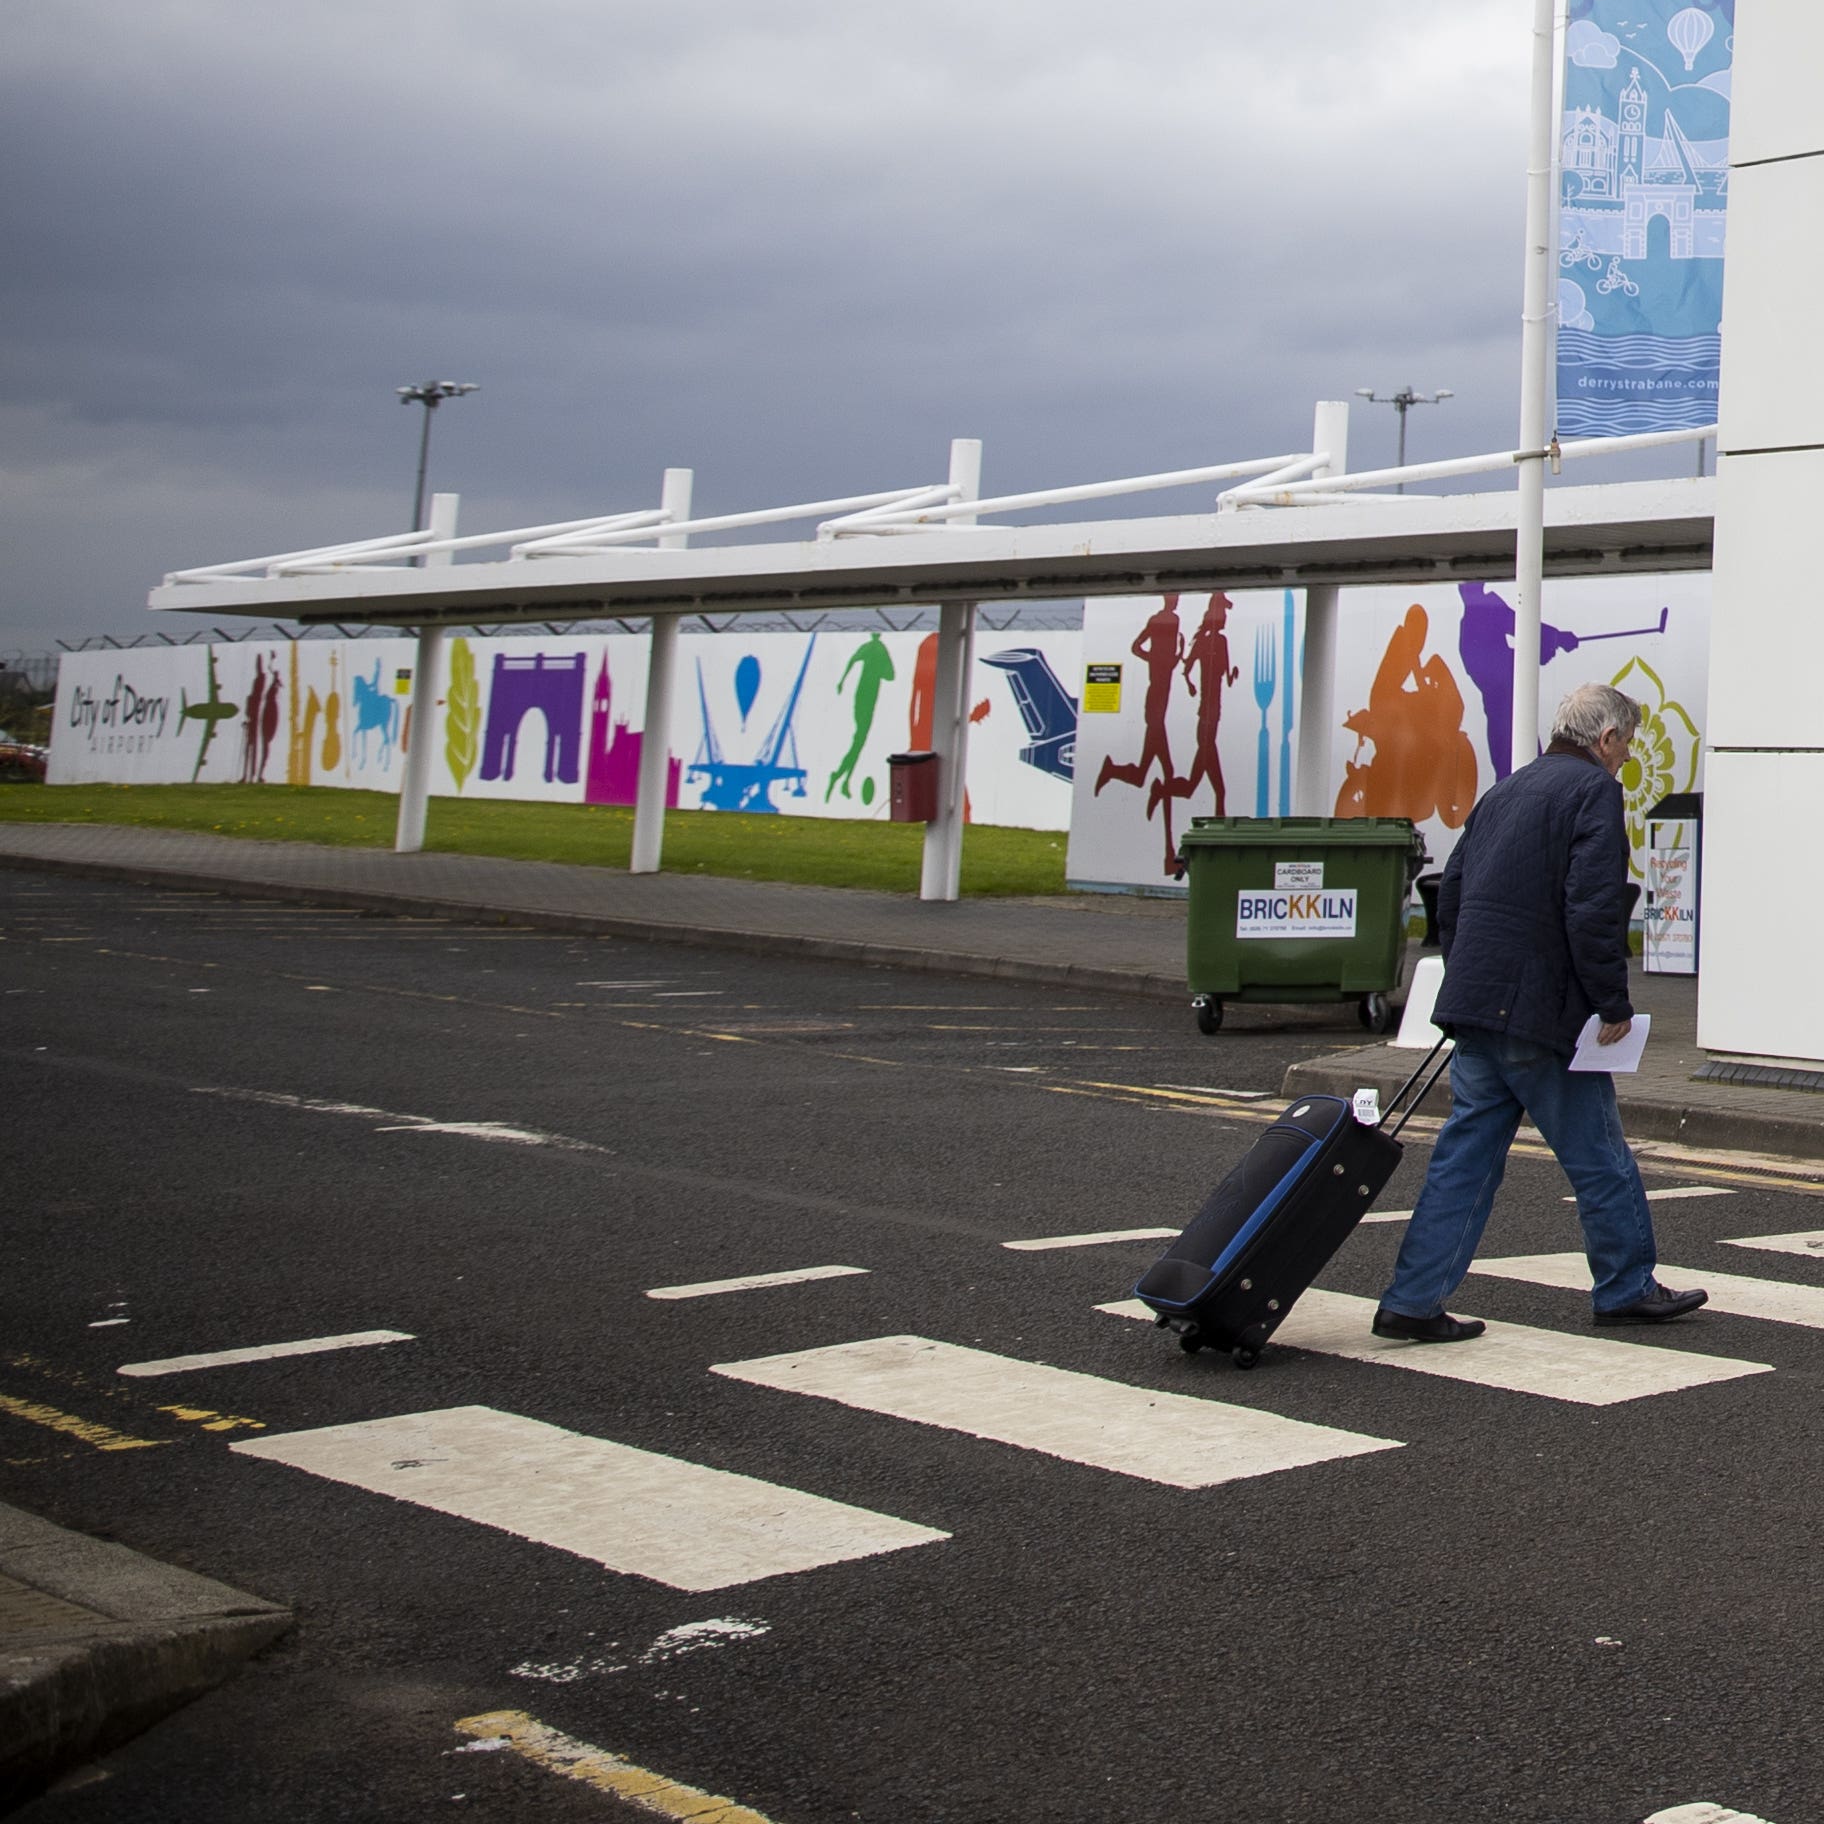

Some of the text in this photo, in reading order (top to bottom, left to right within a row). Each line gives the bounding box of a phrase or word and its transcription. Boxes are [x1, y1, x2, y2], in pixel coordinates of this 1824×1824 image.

[1577, 376, 1719, 391] derrystrabane.com
[70, 673, 171, 740] City of Derry
[90, 735, 155, 754] AIRPORT
[1650, 856, 1688, 871] Recycling
[1276, 868, 1322, 876] CARDBOARD
[1239, 894, 1353, 920] BRICKKILN
[1643, 906, 1694, 922] BRICKKILN
